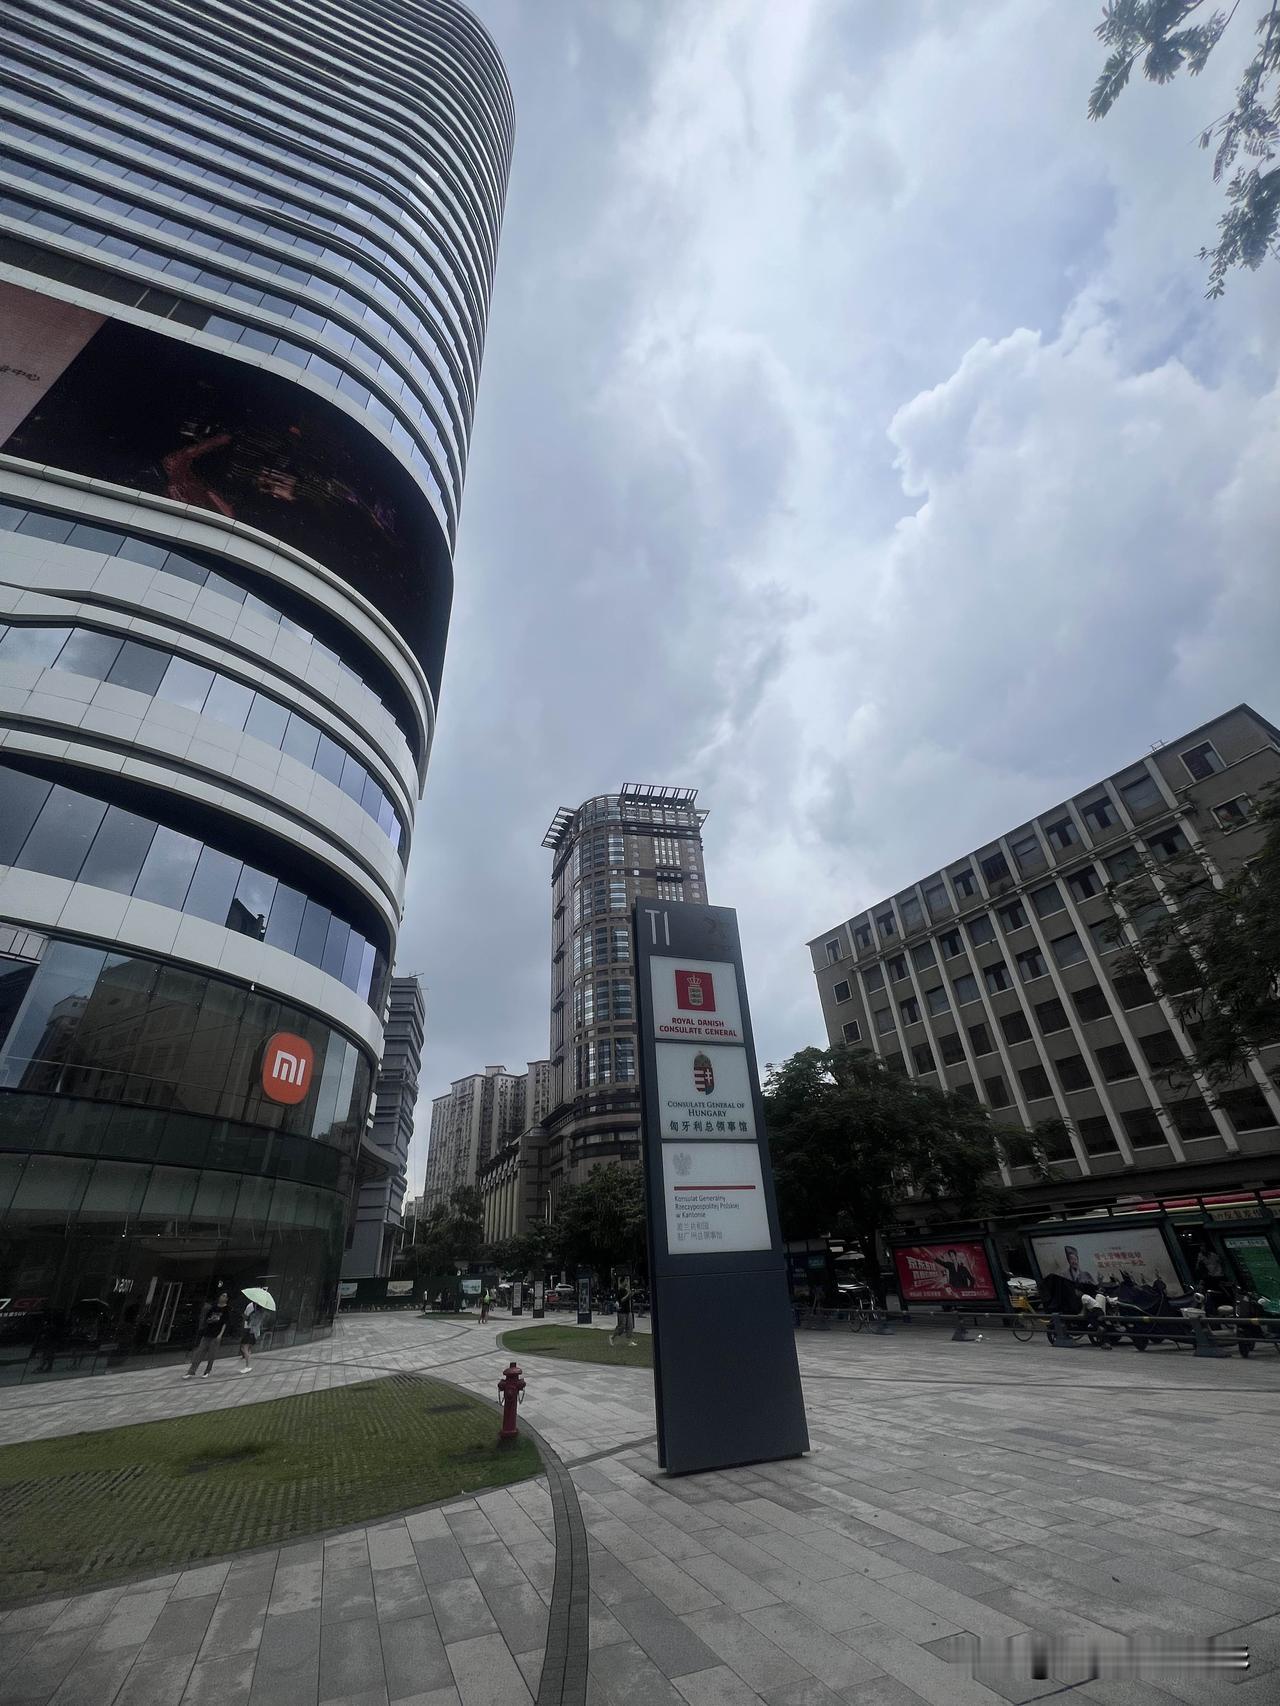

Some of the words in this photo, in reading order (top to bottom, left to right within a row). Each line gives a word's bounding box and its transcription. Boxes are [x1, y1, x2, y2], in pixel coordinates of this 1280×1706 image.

[671, 1017, 695, 1026] ROYAL
[697, 1019, 725, 1027] DANISH
[659, 1025, 702, 1035] CONSULATE
[704, 1028, 737, 1037] GENERAL
[669, 1120, 748, 1133] 匈牙利总领事馆
